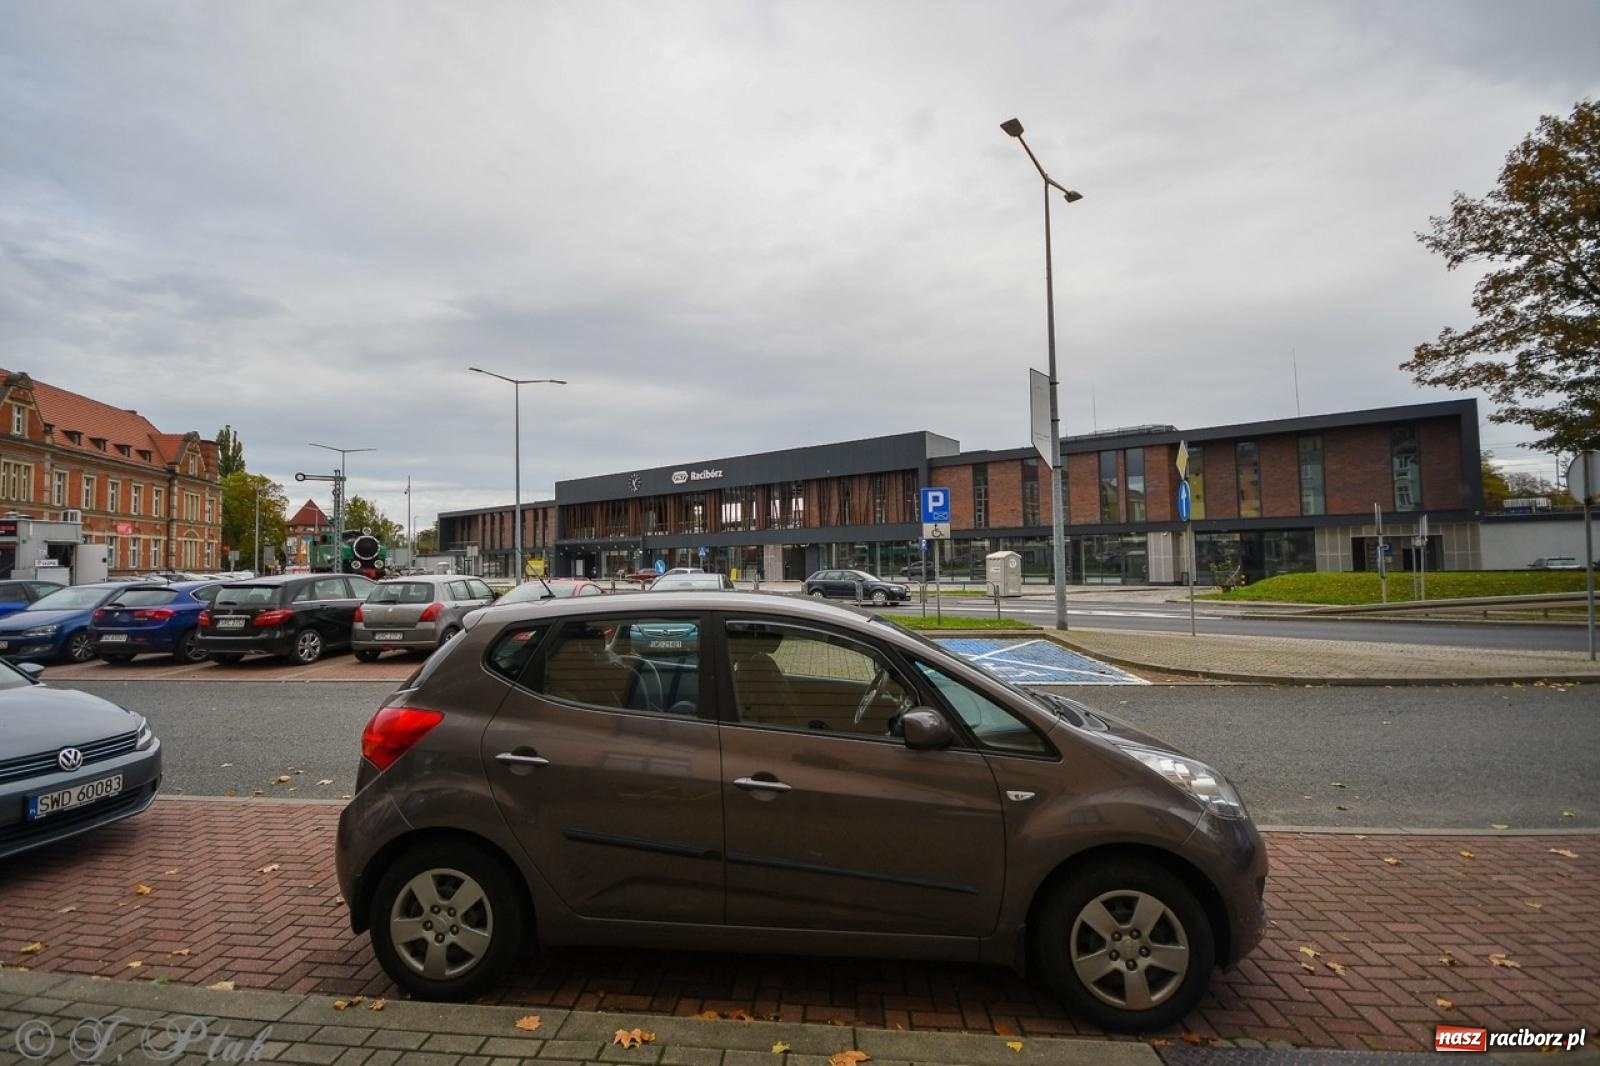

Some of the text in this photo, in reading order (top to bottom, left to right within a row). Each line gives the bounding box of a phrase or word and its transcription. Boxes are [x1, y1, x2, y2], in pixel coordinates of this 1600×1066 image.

[690, 469, 724, 480] Racibórz
[928, 490, 944, 513] P
[39, 776, 121, 812] SWD 60083
